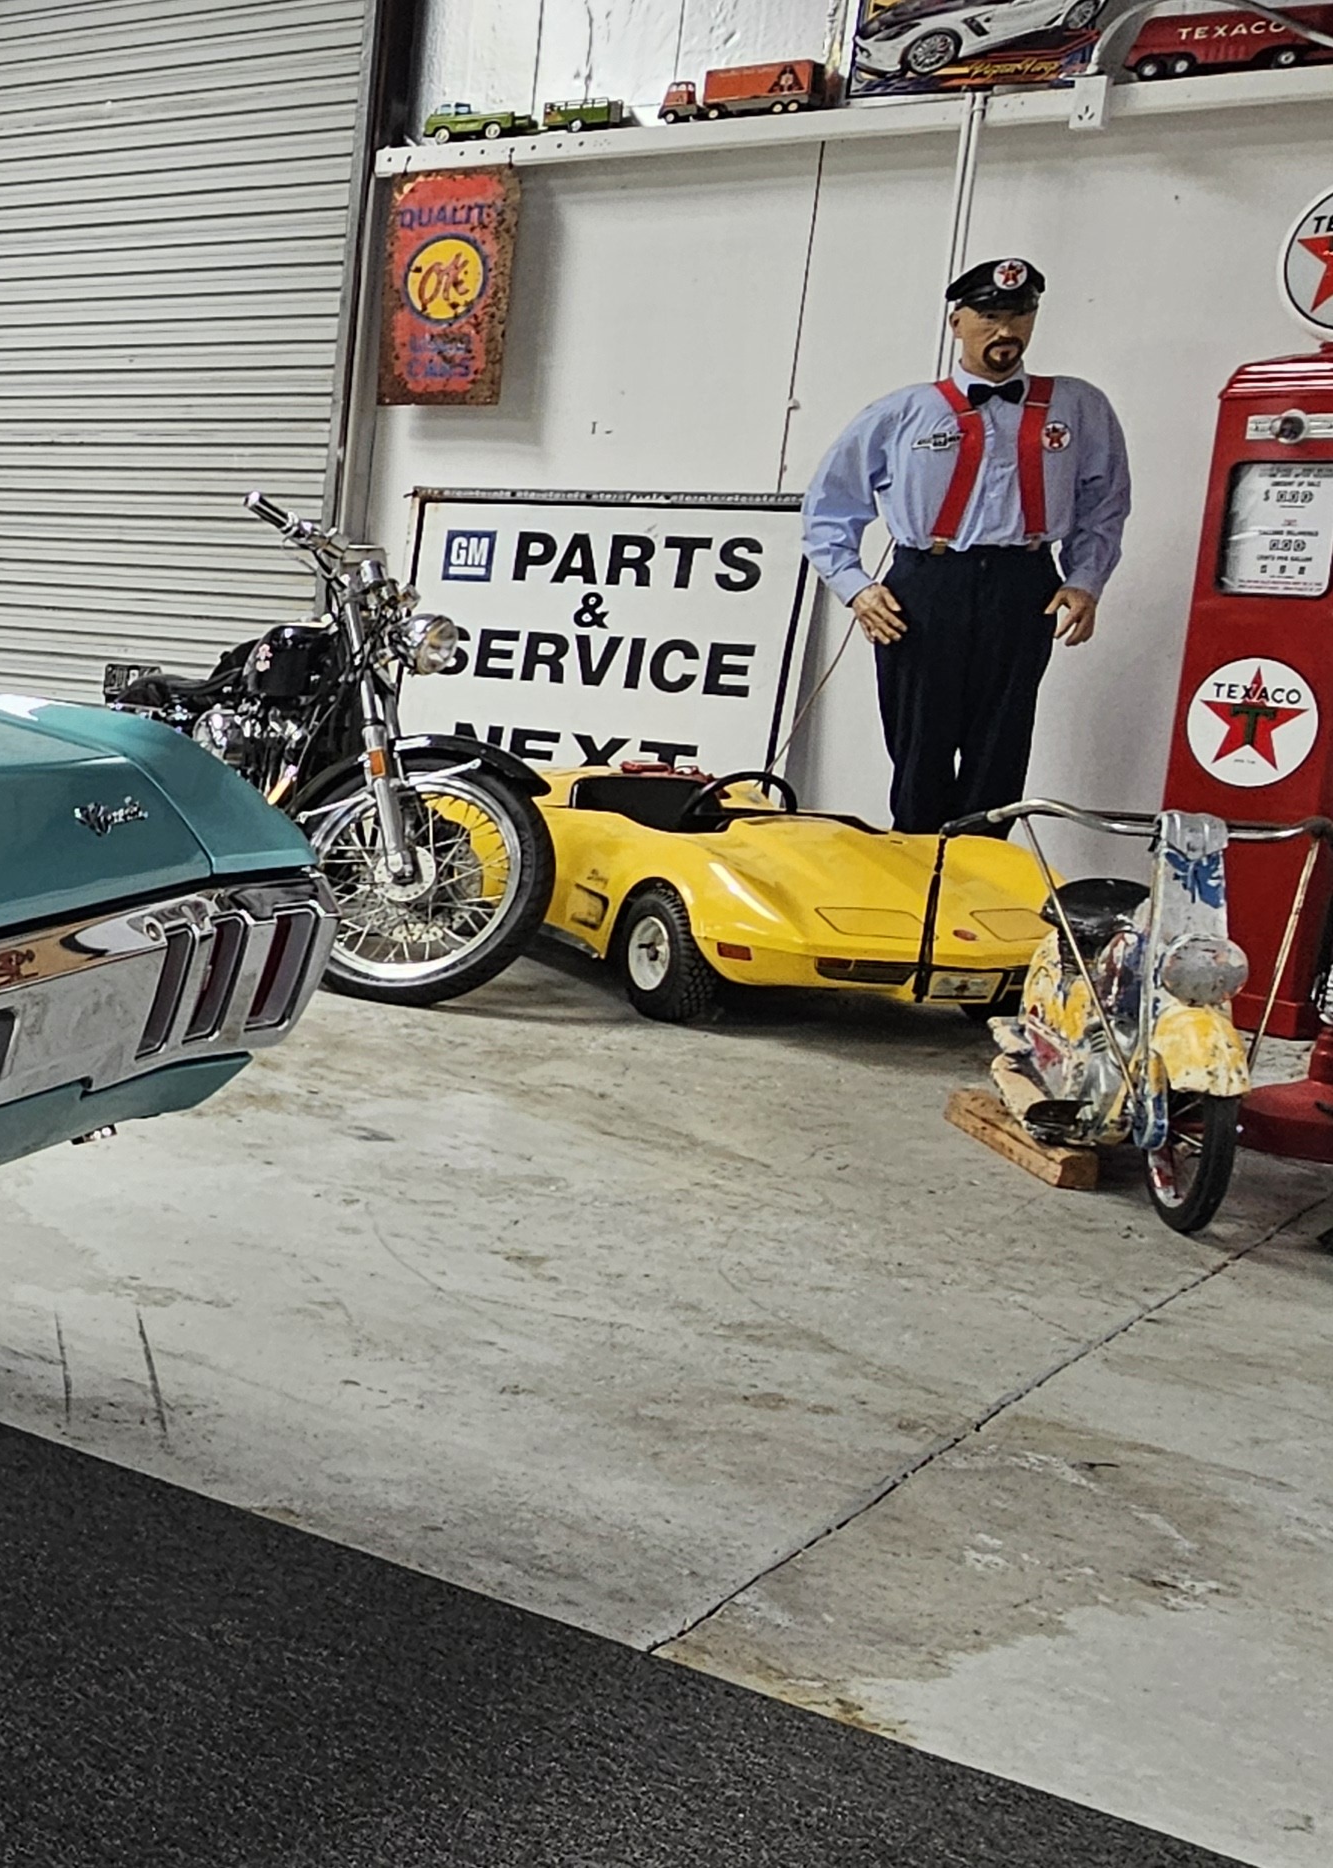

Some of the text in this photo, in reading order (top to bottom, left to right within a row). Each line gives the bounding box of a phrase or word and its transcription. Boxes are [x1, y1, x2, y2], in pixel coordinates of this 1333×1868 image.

[450, 531, 763, 592] GM PARTS
[573, 592, 609, 629] &
[1213, 682, 1302, 705] TEXACO
